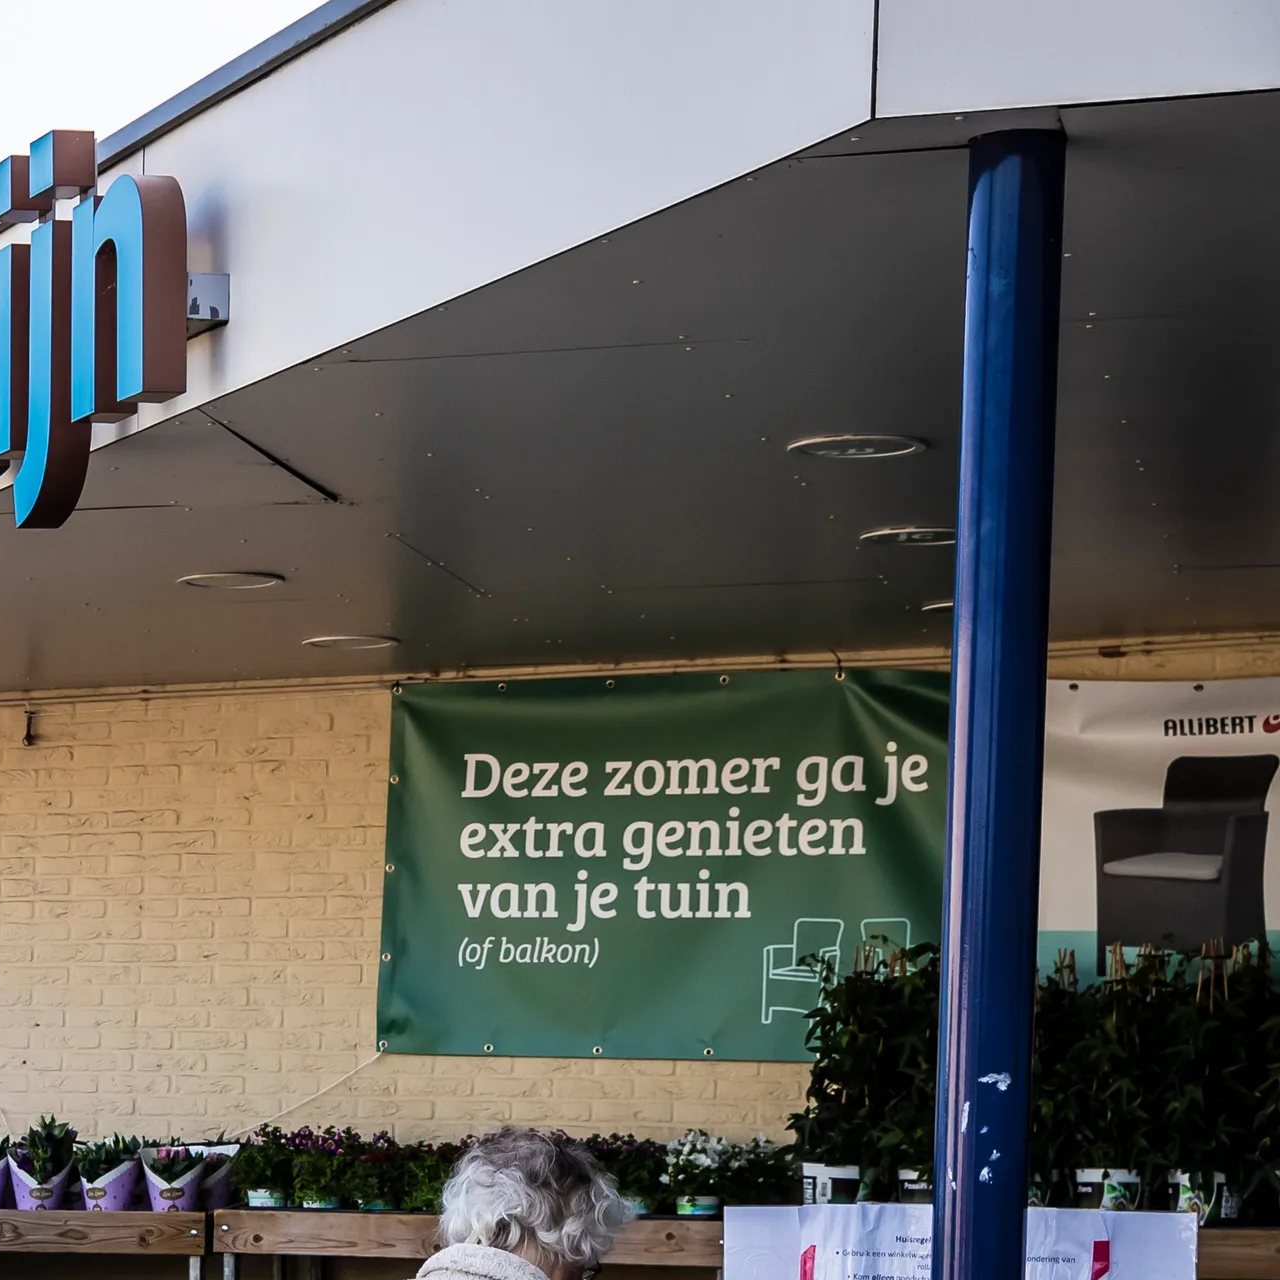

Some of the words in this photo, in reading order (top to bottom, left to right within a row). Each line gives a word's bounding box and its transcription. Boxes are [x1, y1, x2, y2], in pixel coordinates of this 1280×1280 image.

[461, 753, 588, 798] Deze
[604, 756, 780, 797] zomer
[796, 754, 866, 806] ga
[875, 741, 929, 805] je
[459, 815, 606, 859] extra
[622, 806, 866, 871] genieten
[457, 881, 559, 919] van
[566, 870, 618, 932] je
[634, 869, 751, 919] tuin
[457, 937, 493, 969] (of
[498, 936, 599, 968] balkon)
[853, 1273, 870, 1280] Kom
[871, 1273, 895, 1280] alleen
